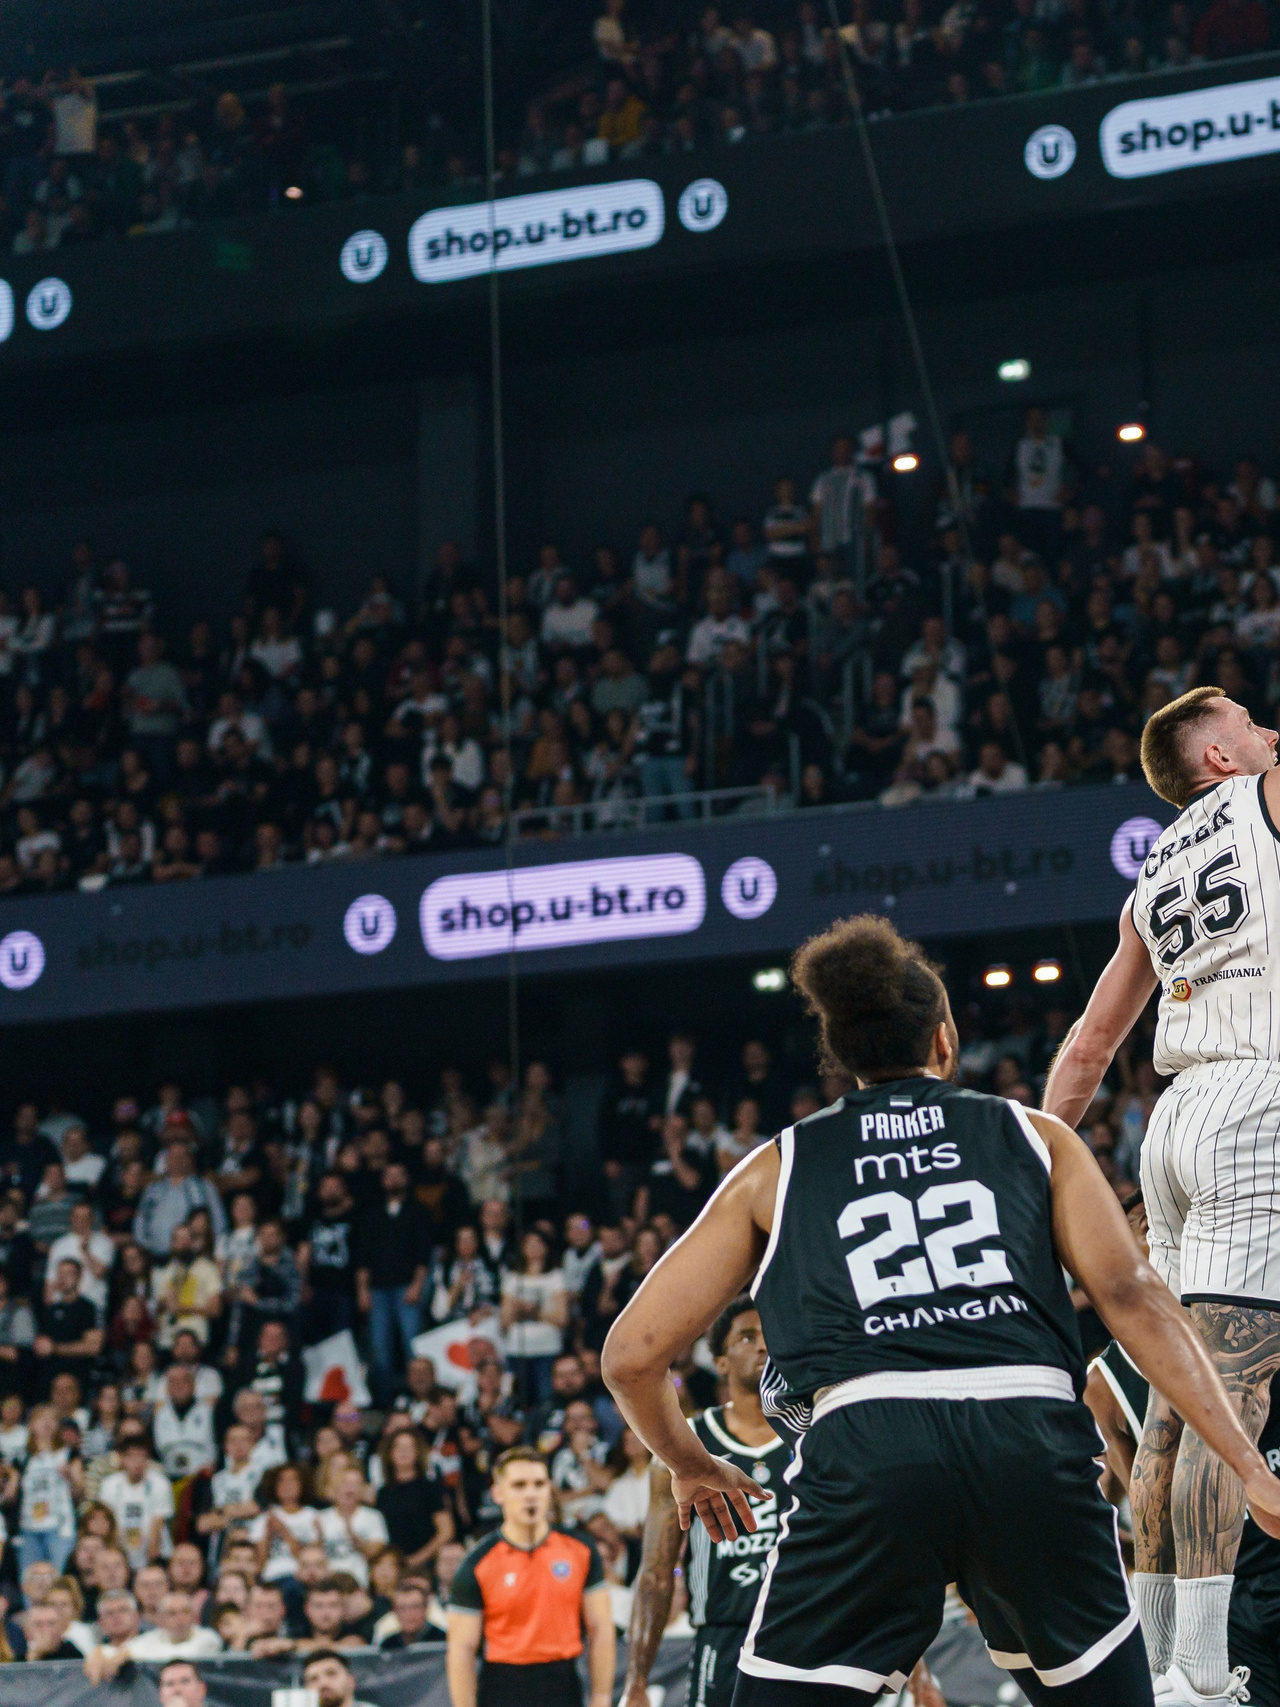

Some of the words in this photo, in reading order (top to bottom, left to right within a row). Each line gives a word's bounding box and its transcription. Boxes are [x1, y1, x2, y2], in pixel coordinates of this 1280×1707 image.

[427, 206, 648, 260] shop.u-bt.ro
[440, 883, 686, 935] shop.u-bt.ro
[1146, 844, 1250, 968] 55
[860, 1105, 946, 1142] PARKER
[853, 1142, 961, 1185] mts
[836, 1180, 1014, 1311] 22
[863, 1294, 1029, 1336] CHANGAN
[716, 1532, 778, 1560] MOZZ
